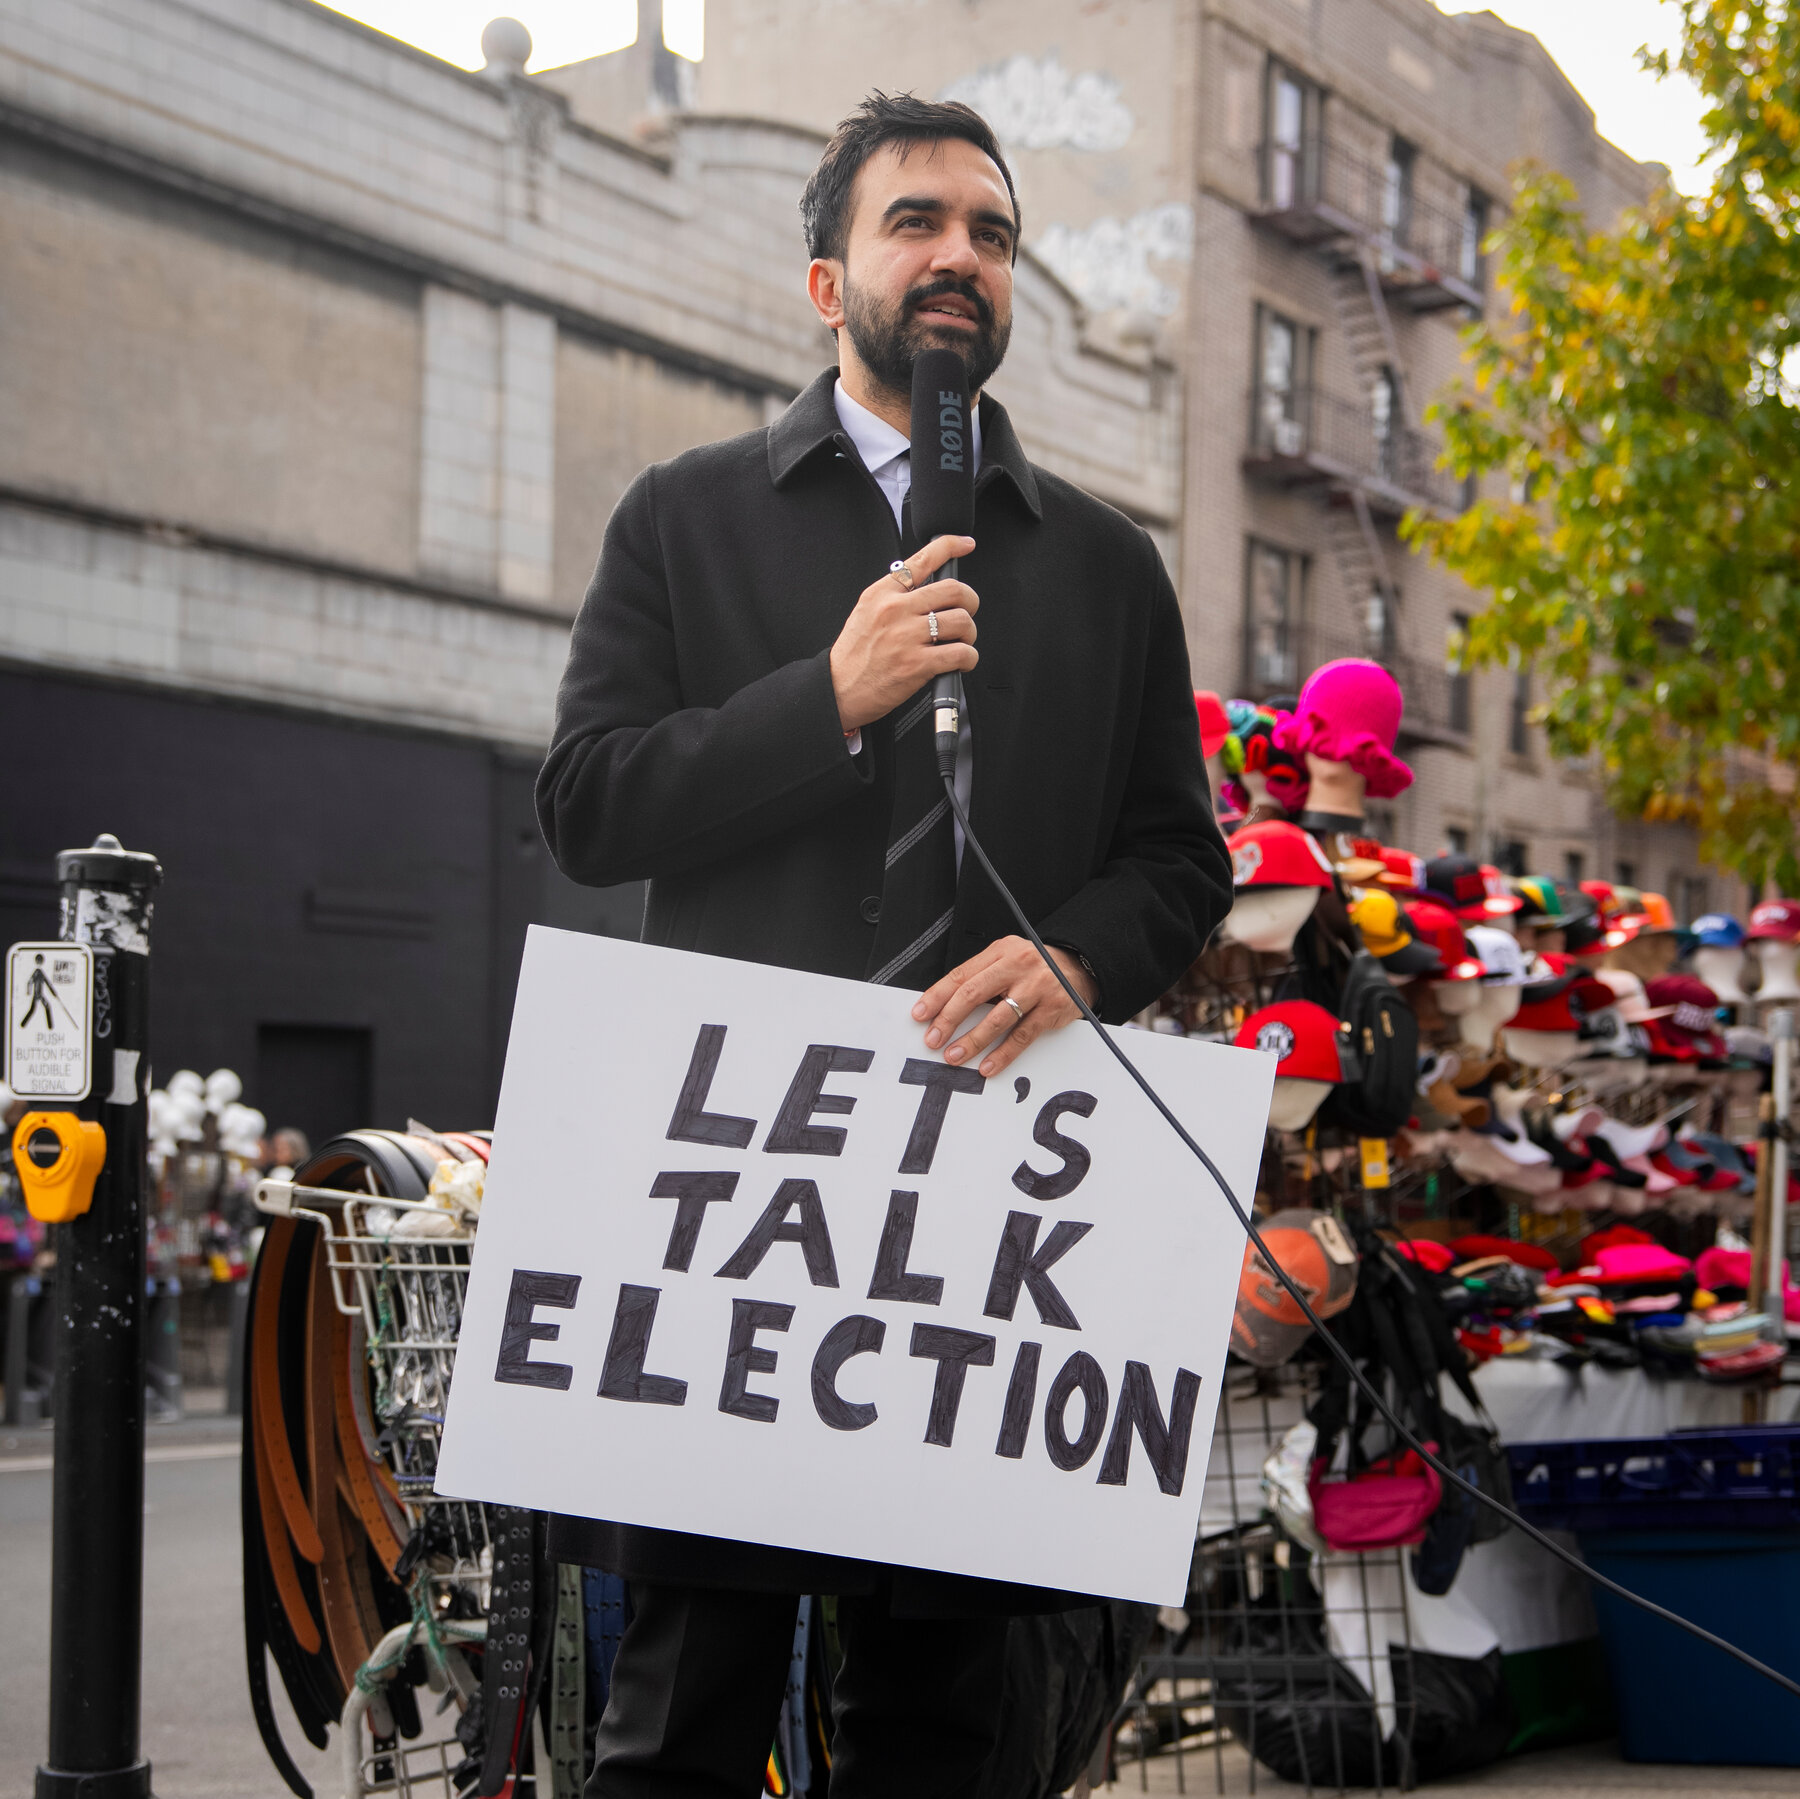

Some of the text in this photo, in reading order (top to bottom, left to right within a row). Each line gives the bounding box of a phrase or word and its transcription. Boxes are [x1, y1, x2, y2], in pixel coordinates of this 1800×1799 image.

[940, 390, 964, 472] RØDE
[16, 1048, 81, 1061] BUTTON FOR
[36, 1032, 66, 1046] PUSH
[28, 1064, 71, 1077] AUDIBLE
[31, 1079, 66, 1092] SIGNAL
[666, 1024, 1097, 1200] LET'S
[649, 1172, 1094, 1331] TALK
[495, 1269, 1202, 1497] ELECTION
